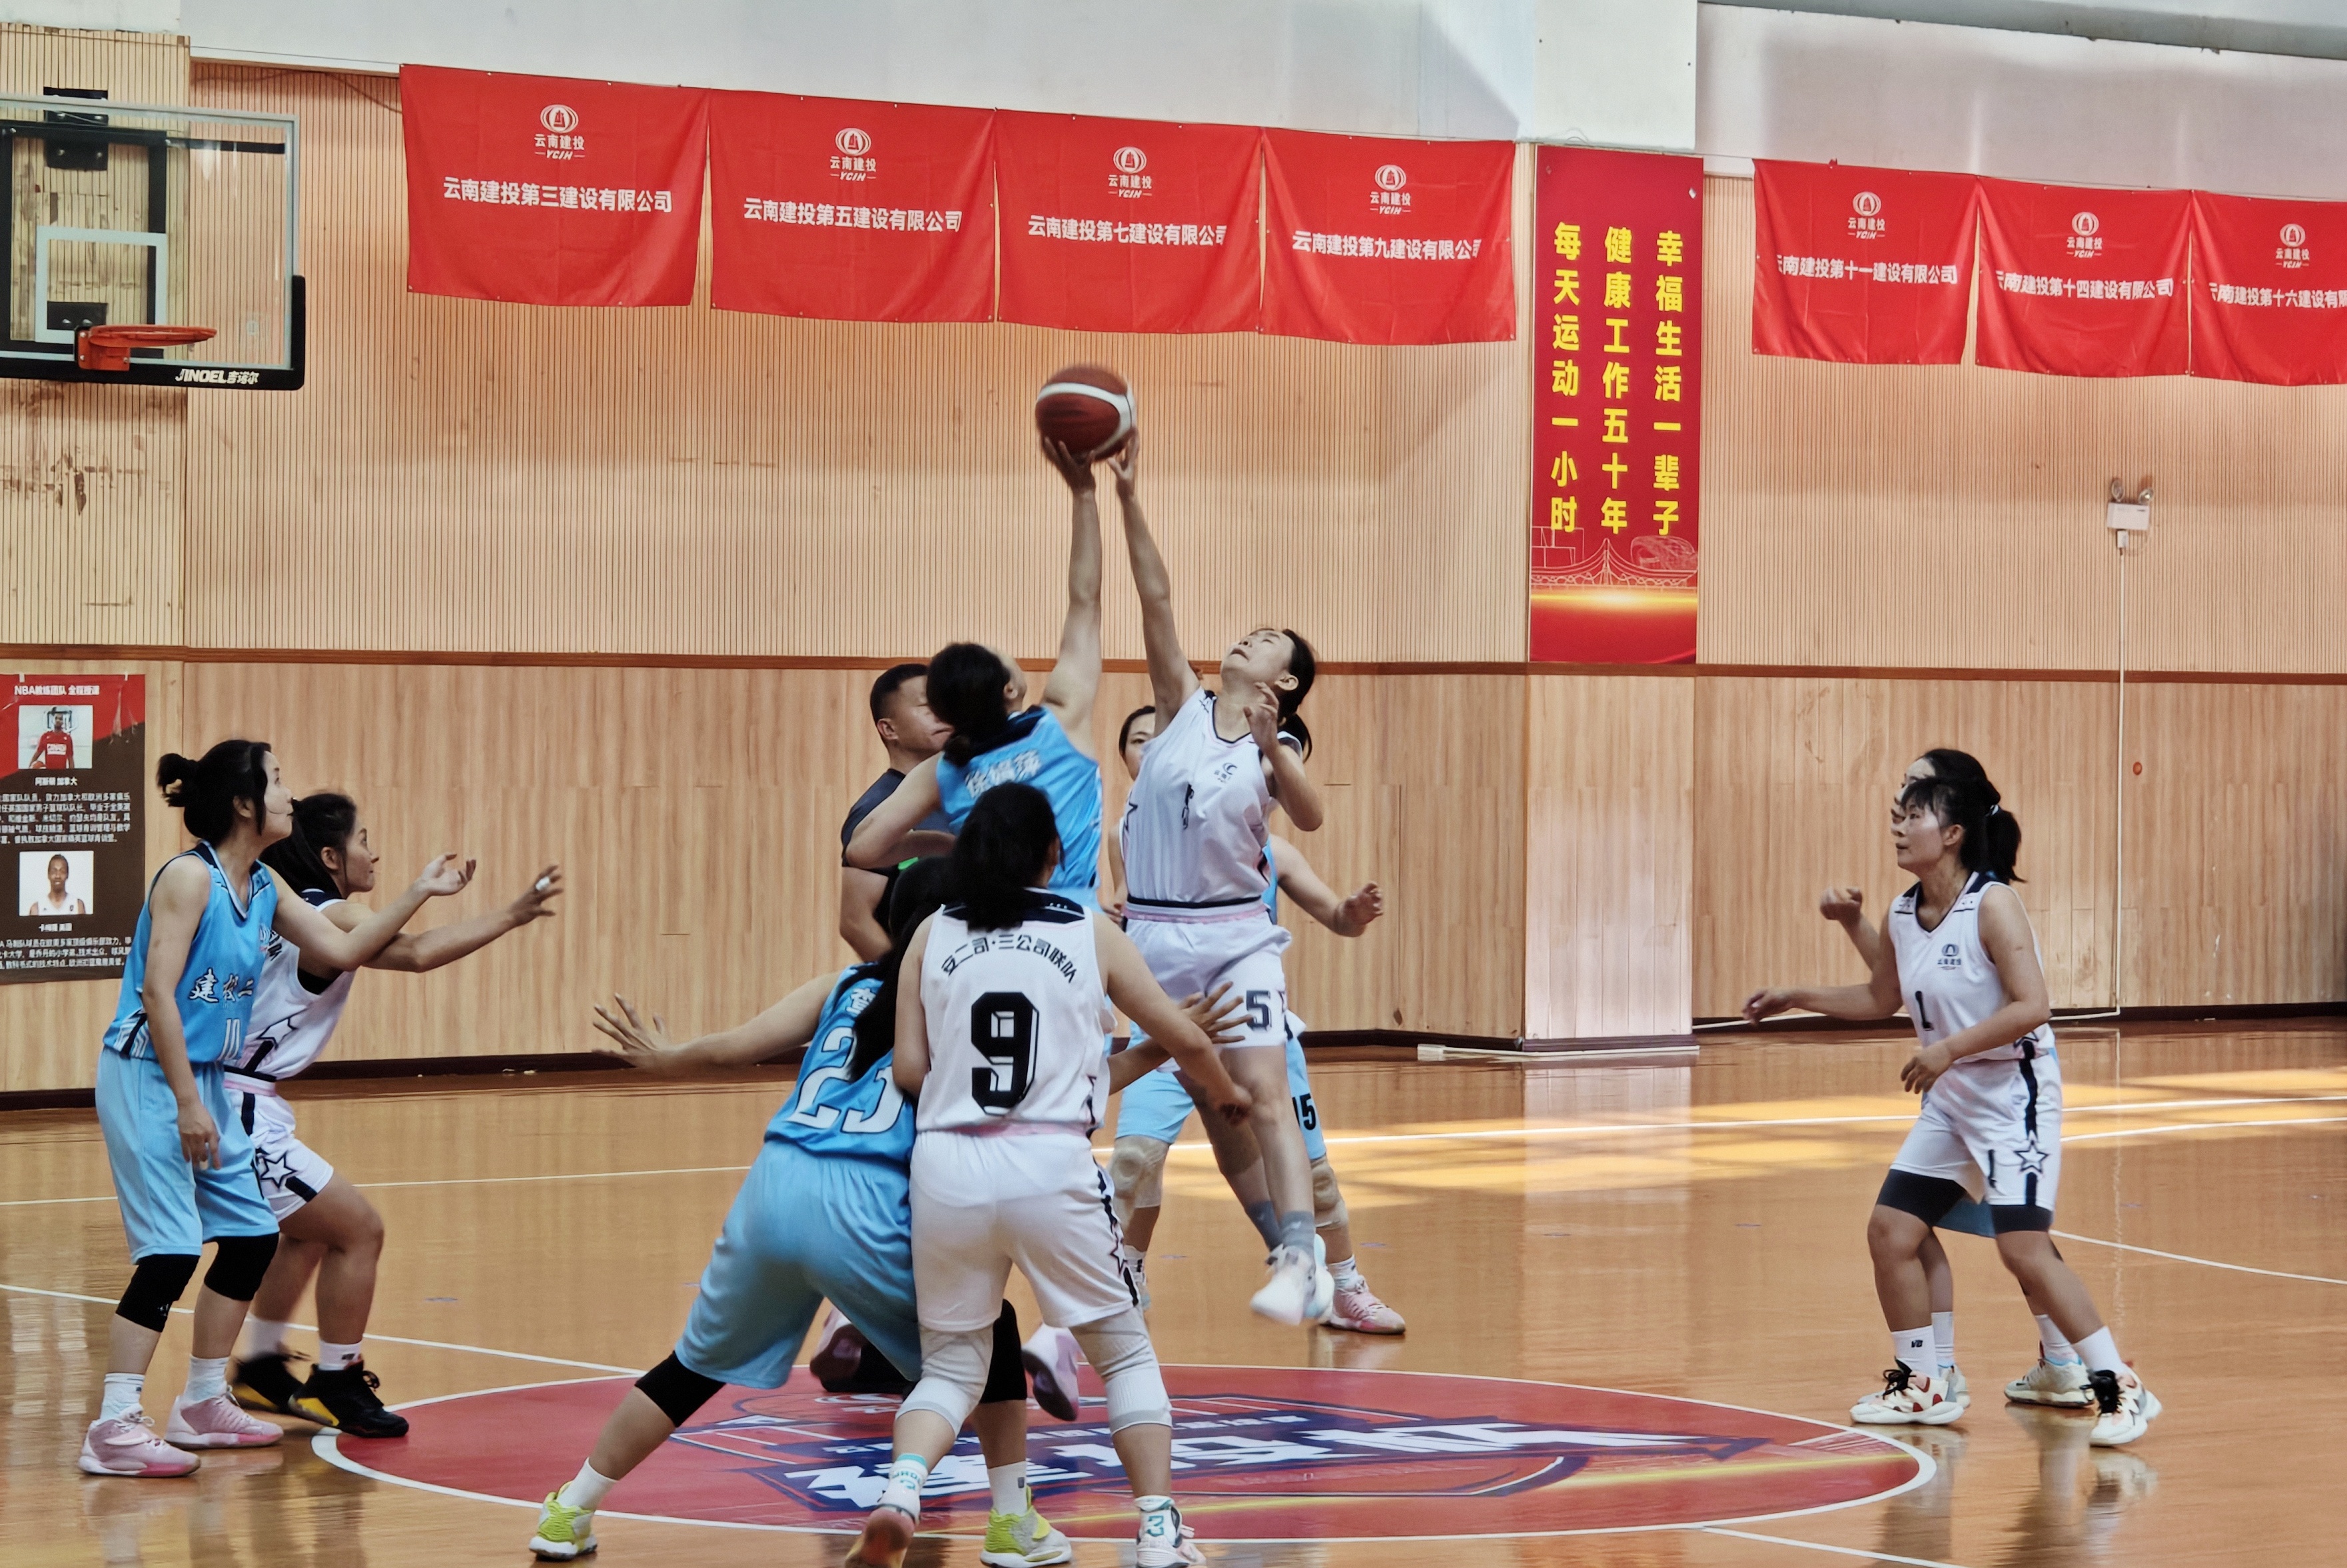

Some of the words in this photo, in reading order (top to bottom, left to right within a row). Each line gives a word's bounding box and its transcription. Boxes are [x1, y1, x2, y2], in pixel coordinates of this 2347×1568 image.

[534, 133, 585, 151] 云南建投
[546, 149, 574, 161] YCIH
[829, 155, 877, 173] 云南建投
[839, 171, 867, 182] YCIH
[1107, 174, 1153, 189] 云南建投
[442, 176, 673, 214] 云南建投第三建设有限公司
[1118, 189, 1143, 198] YCIH
[1369, 191, 1411, 206] 云南建投
[743, 196, 963, 232] 云南建投第五建设有限公司
[1847, 216, 1886, 231] 云南建投
[1027, 214, 1228, 246] 云南建投第七建设有限公司
[2067, 236, 2103, 250] 云南建投
[1550, 220, 1582, 534] 每天运动一小时
[1600, 225, 1633, 535] 健康工作五十年
[1652, 229, 1684, 536] 幸福生活一辈子
[1246, 990, 1272, 1030] 5
[1915, 990, 1933, 1031] 1
[971, 991, 1041, 1116] 9
